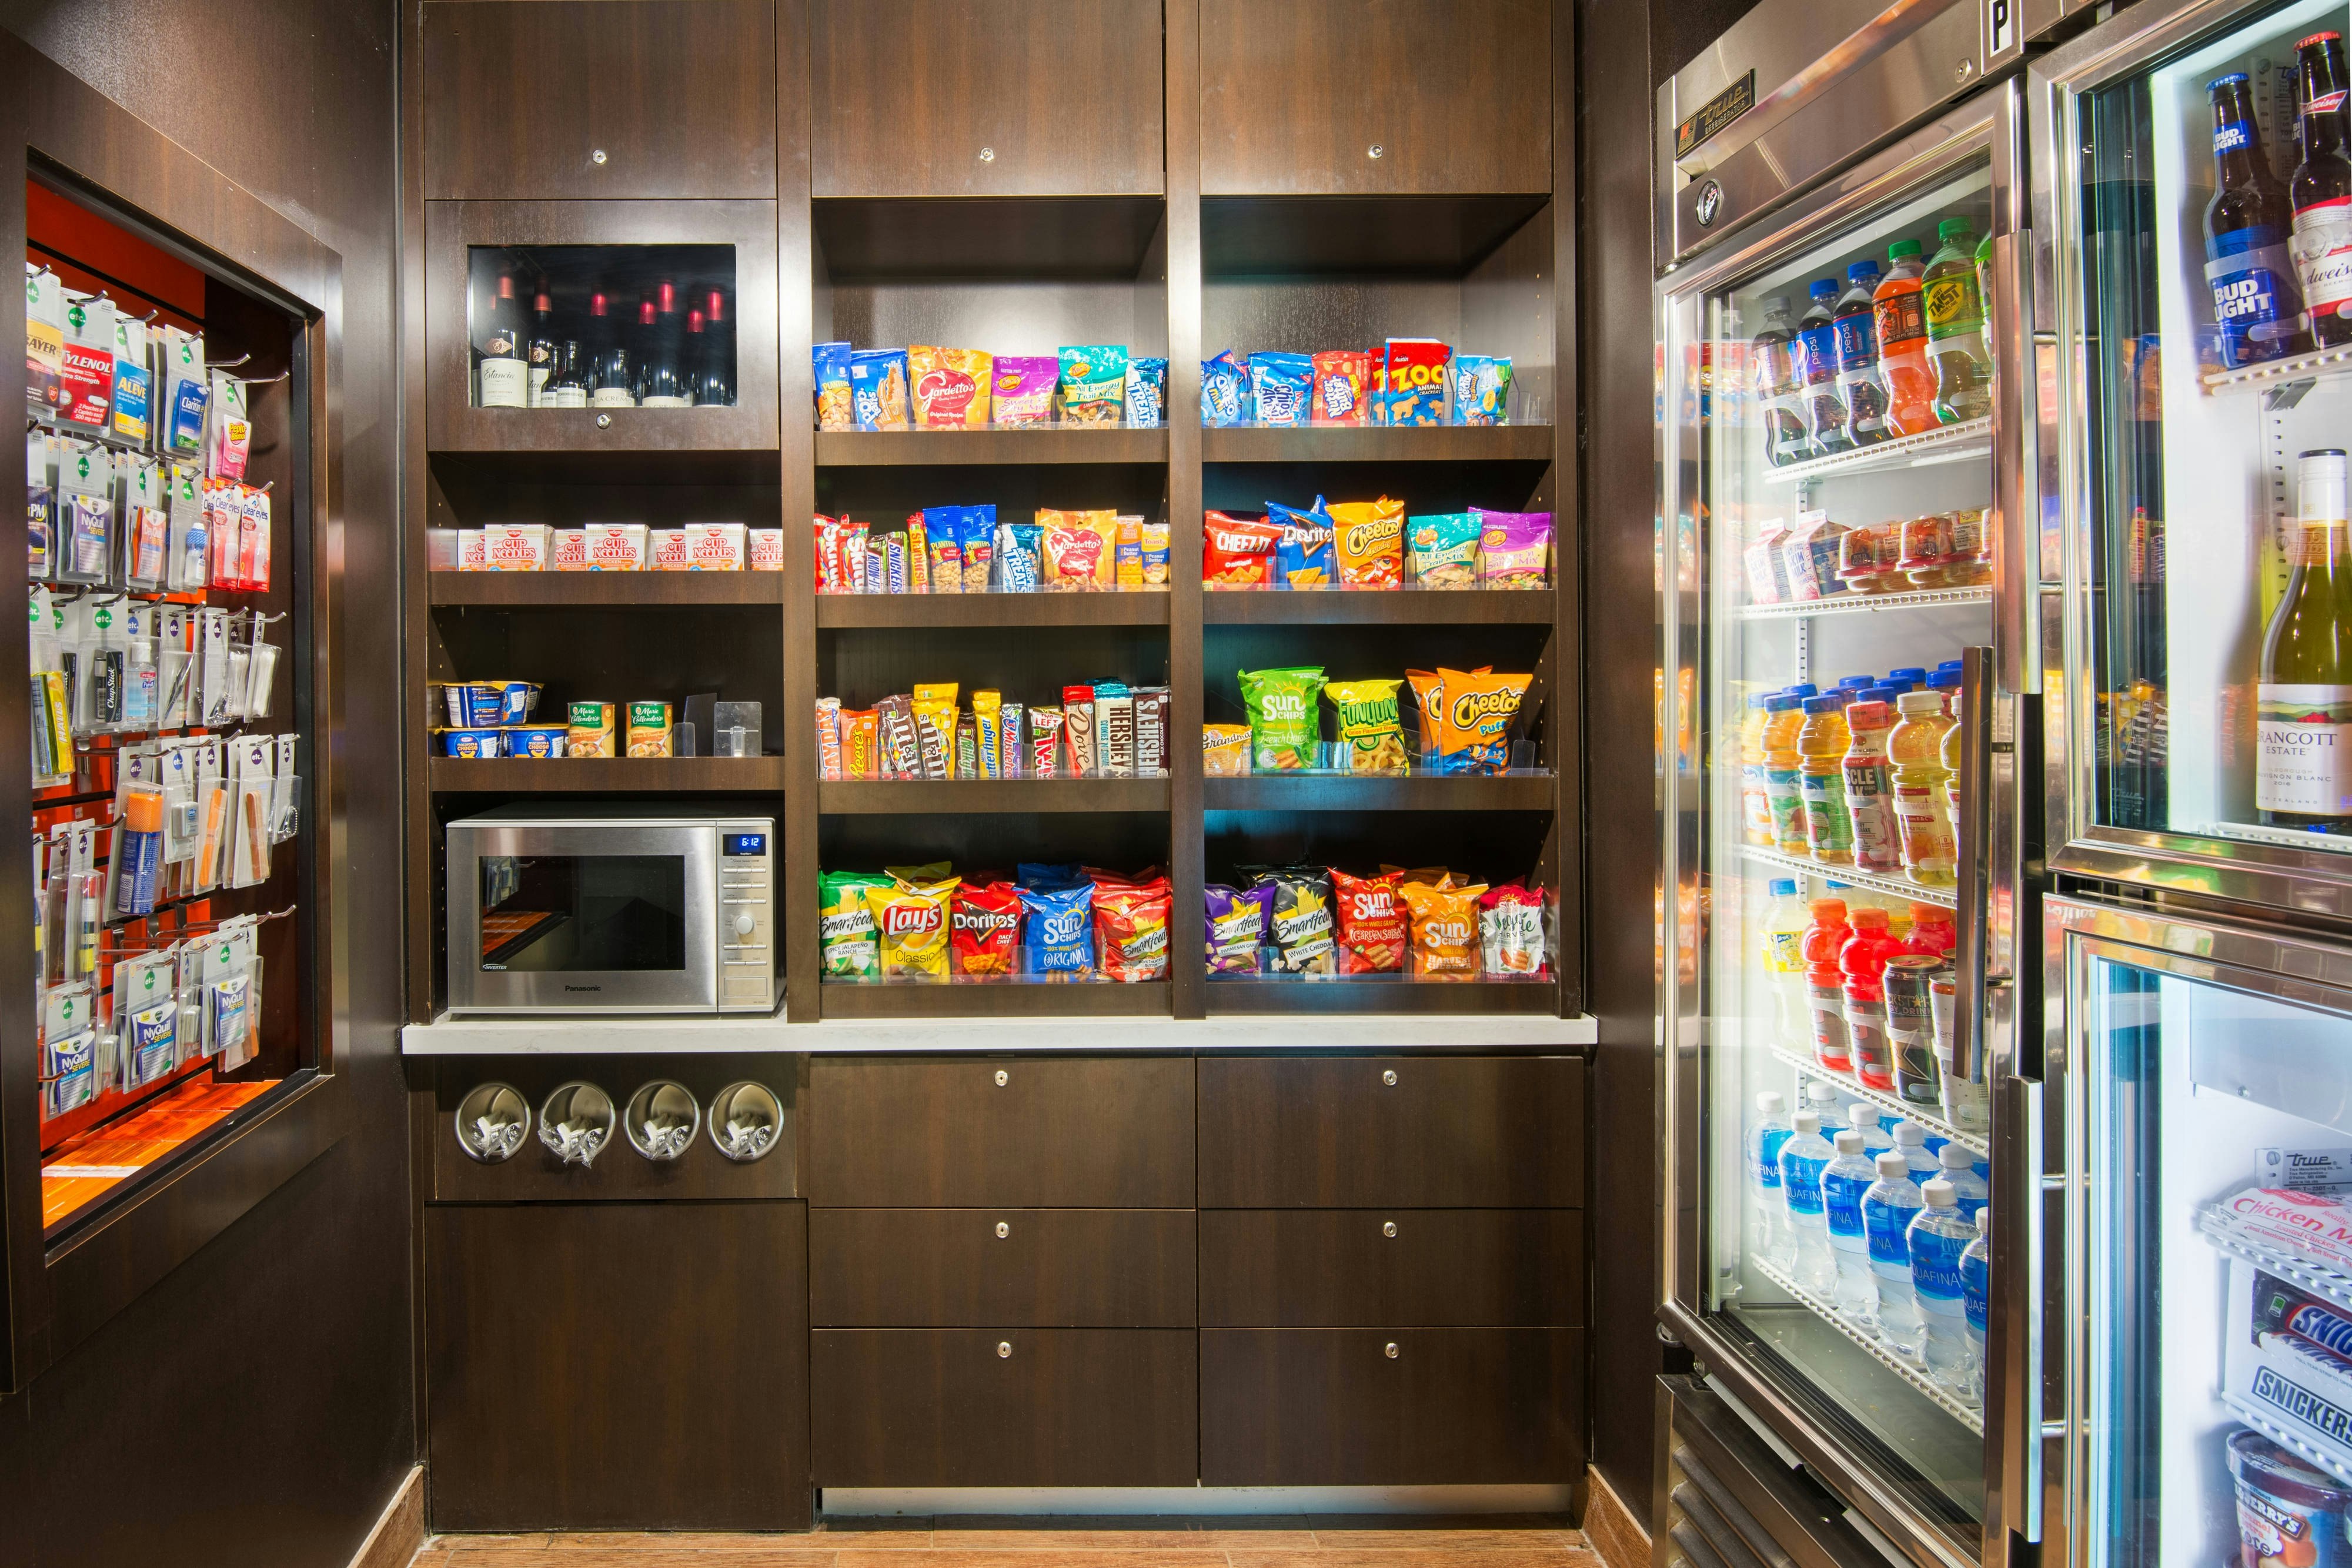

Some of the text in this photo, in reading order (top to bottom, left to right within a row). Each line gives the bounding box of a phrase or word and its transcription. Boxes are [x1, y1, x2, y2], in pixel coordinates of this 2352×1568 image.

[2213, 134, 2246, 152] LIGHT
[2214, 128, 2239, 143] BUD
[1932, 287, 1943, 299] MIST
[2214, 279, 2259, 305] BUD
[2214, 292, 2272, 323] LIGHT
[69, 313, 86, 323] etc.
[1842, 323, 1854, 353] pepsi
[1808, 336, 1821, 365] pepsi
[1071, 363, 1090, 375] Kar's
[74, 374, 100, 385] Strength
[823, 380, 850, 390] PLANTERS
[1348, 373, 1362, 400] Bites
[1391, 364, 1443, 394] ZOO
[117, 376, 146, 399] ALEVE
[917, 372, 975, 413] Gardetto's
[1088, 382, 1120, 393] Energy
[1098, 390, 1116, 399] Mix
[1215, 374, 1235, 417] OREO
[1335, 376, 1352, 413] Butter
[181, 397, 201, 412] Claritin
[1083, 400, 1105, 409] UNSALTED
[1127, 382, 1150, 428] TREATS
[1323, 379, 1338, 418] Nutter
[229, 423, 247, 434] Pepto-
[230, 433, 246, 441] Bismol
[215, 497, 240, 514] Clear eyes
[243, 504, 269, 520] Clear eyes
[81, 513, 105, 529] NyQuil
[89, 527, 105, 536] SEVERE
[1284, 526, 1333, 543] Dorito
[1348, 519, 1401, 556] Cheetos
[1418, 530, 1437, 542] Kar's
[1485, 532, 1504, 543] Kar's
[502, 538, 527, 549] CUP
[564, 543, 586, 553] CUP
[603, 538, 628, 549] CUP
[666, 543, 686, 553] CUP
[703, 538, 727, 549] CUP
[757, 543, 781, 553] CUP
[930, 541, 957, 550] PLANTERS
[964, 541, 990, 550] PLANTERS
[1048, 531, 1101, 563] Gardetto's
[1217, 532, 1272, 553] CHEEZ-IT
[1365, 540, 1392, 557] Crunchy
[492, 547, 536, 559] NOODLES
[593, 547, 637, 559] NOODLES
[693, 547, 736, 559] NOODLES
[1419, 544, 1468, 561] All Energy
[1422, 553, 1465, 566] Trail Mix
[1917, 547, 1935, 556] GOLD
[888, 543, 903, 594] SNICKERS
[1003, 547, 1027, 593] TREATS
[96, 615, 112, 623] etc.
[106, 667, 116, 708] ChapStick
[1262, 695, 1306, 721] Sun
[1277, 711, 1305, 720] CHIPS
[1454, 688, 1523, 727] Cheetos
[55, 701, 68, 743] HALLS
[570, 714, 599, 724] Callender's
[632, 714, 662, 724] Callender's
[1035, 718, 1058, 727] LEFT
[817, 707, 840, 780] PAYDAY
[1110, 707, 1132, 778] HERSHEY'S
[1138, 700, 1160, 777] HERSHEY'S
[1257, 729, 1311, 745] French Onion
[848, 729, 865, 781] Reese's
[2266, 746, 2307, 756] ESTATE
[131, 765, 142, 773] etc.
[1810, 801, 1823, 810] Apple
[741, 837, 759, 847] 6:12
[1353, 892, 1391, 920] Sun
[1370, 908, 1395, 917] CHIPS
[888, 902, 942, 936] Lay's
[953, 912, 1017, 930] Doritos
[1213, 912, 1262, 938] Smartfood
[1277, 910, 1331, 941] Smartfood
[1044, 918, 1084, 944] Sun
[1059, 931, 1081, 942] CHIPS
[1425, 922, 1471, 948] Sun
[827, 942, 868, 954] SPICY JALAPEÑO
[1122, 928, 1168, 957] Smartfood
[1289, 941, 1334, 958] WHITE CHEDDAR
[1441, 937, 1469, 947] CHIPS
[220, 951, 231, 959] etc.
[895, 950, 936, 963] Classic
[1044, 950, 1090, 967] ORIGINAL
[1428, 955, 1471, 964] HARVEST
[1426, 962, 1472, 970] CHEDDAR
[222, 990, 244, 1008] NyQuil
[230, 999, 245, 1010] SEVERE
[143, 1019, 171, 1040] NyQuil
[153, 1029, 173, 1043] SEVERE
[62, 1049, 89, 1069] NyQuil
[71, 1059, 91, 1072] SEVERE
[2286, 1153, 2332, 1166] true
[2233, 1197, 2324, 1232] Chicken
[2248, 1225, 2306, 1249] Real American Cheese
[2274, 1223, 2337, 1250] Roasted Chicken
[2311, 1246, 2340, 1262] Soft Bread
[2259, 1372, 2352, 1443] SNICKERS
